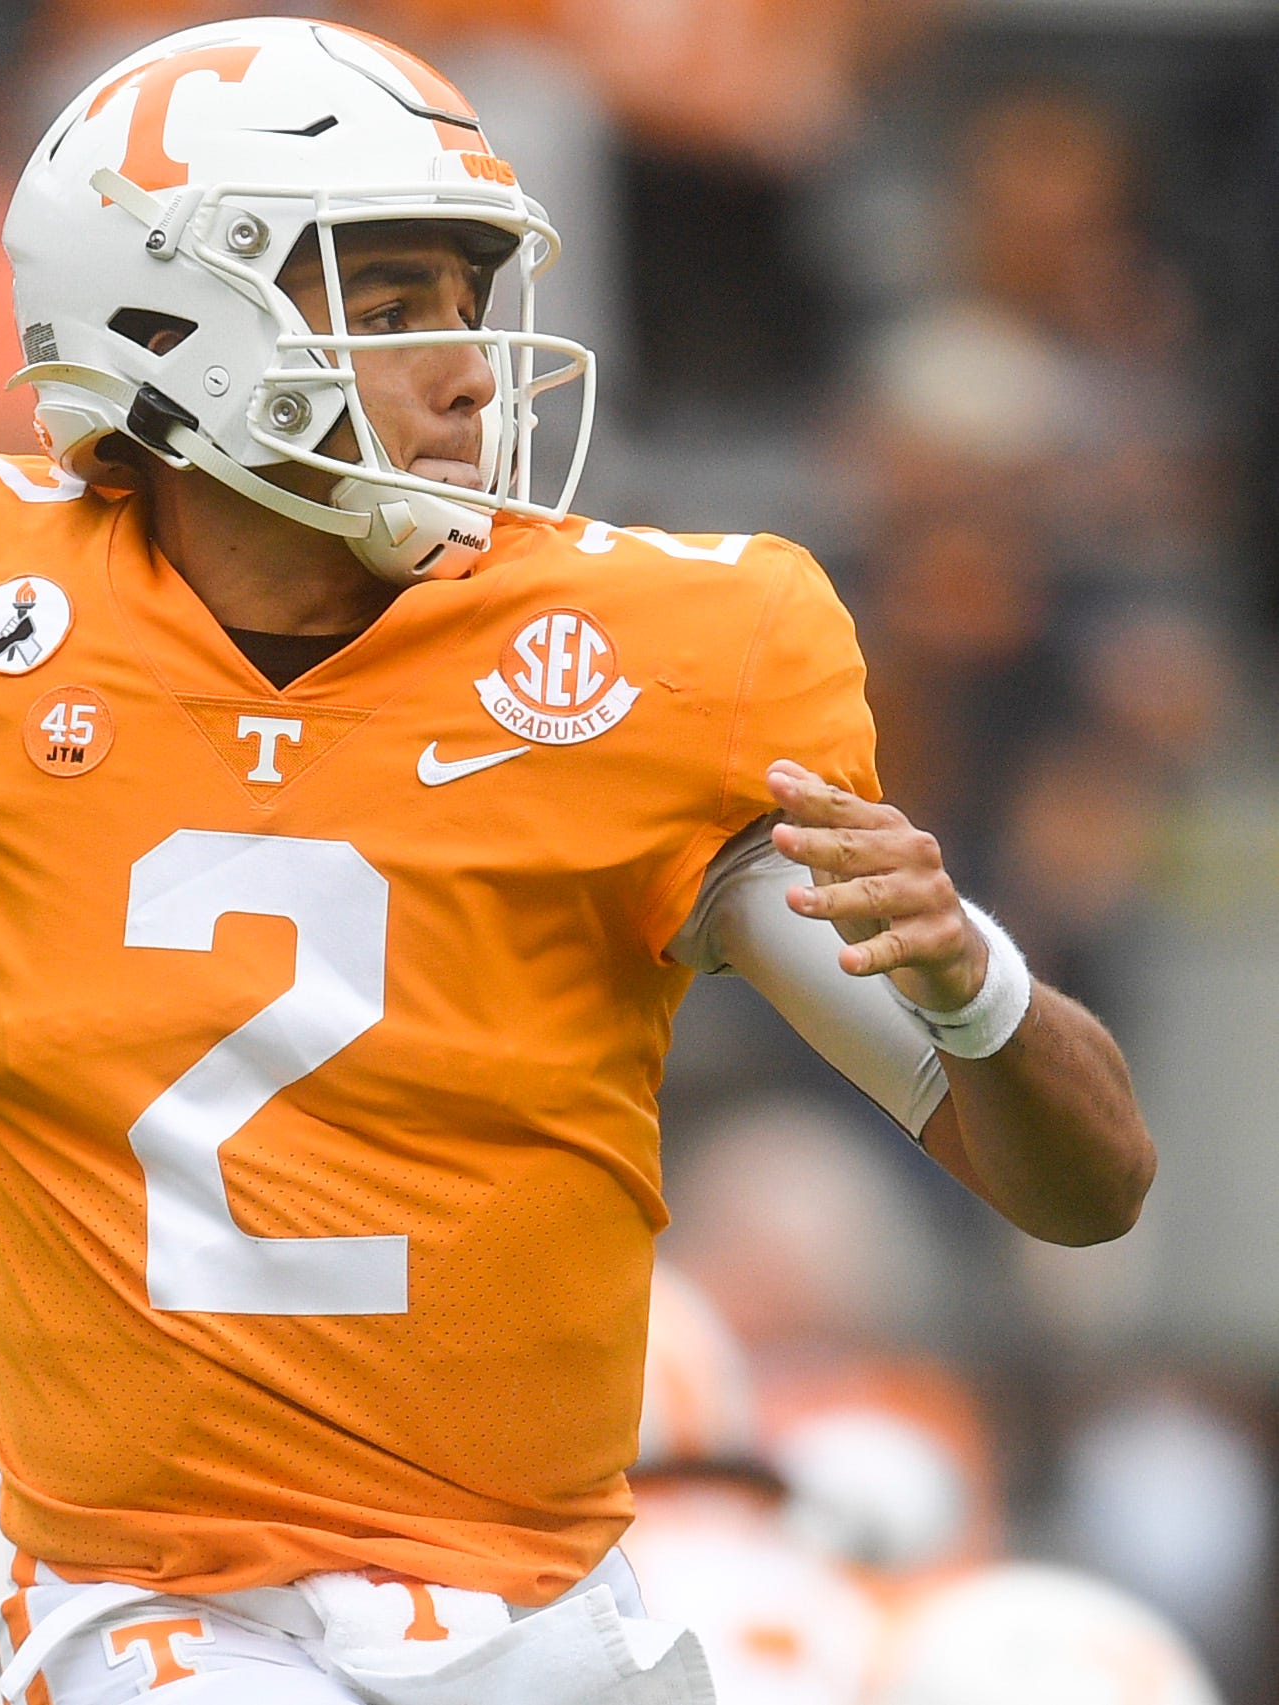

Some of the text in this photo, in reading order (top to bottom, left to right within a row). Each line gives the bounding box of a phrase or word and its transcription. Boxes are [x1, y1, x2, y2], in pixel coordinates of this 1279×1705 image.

[86, 46, 261, 207] T
[447, 528, 486, 552] Riddel
[513, 613, 608, 707] SEC
[40, 702, 97, 746] 45
[237, 715, 303, 783] T
[492, 696, 616, 742] GRADUATE
[46, 746, 85, 764] JTM
[124, 828, 409, 1316] 2
[109, 1617, 205, 1690] T
